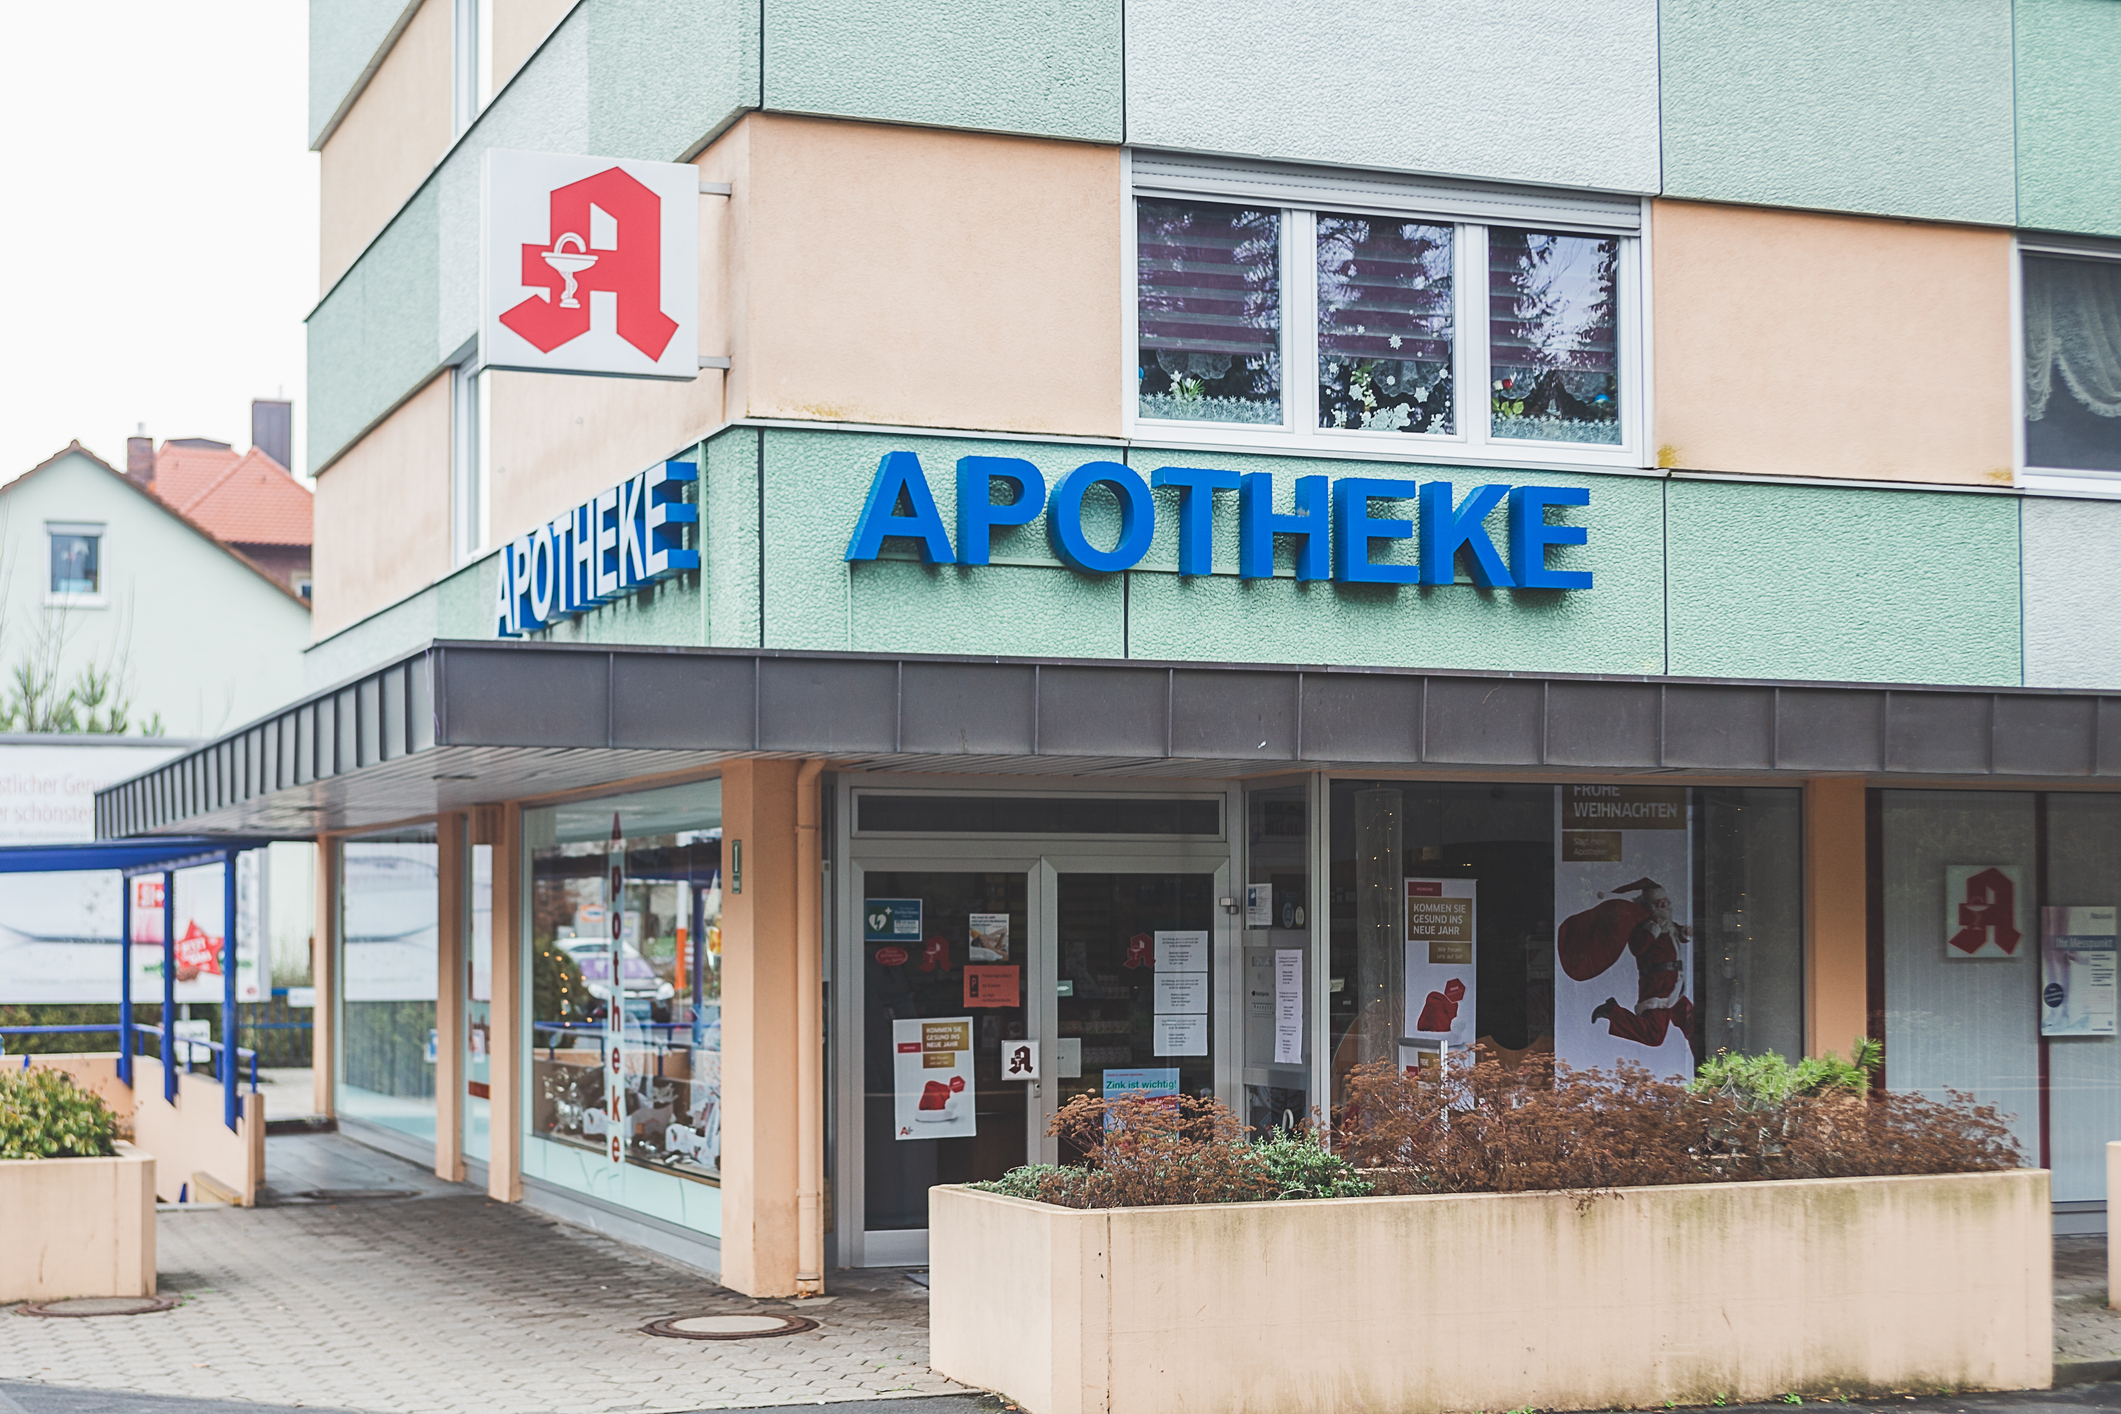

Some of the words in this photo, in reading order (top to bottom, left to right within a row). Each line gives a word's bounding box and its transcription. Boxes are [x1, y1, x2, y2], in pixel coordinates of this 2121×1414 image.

[846, 450, 1594, 592] APOTHEKE
[495, 461, 698, 641] APOTHEKE
[1573, 802, 1678, 818] WEIHNACHTEN
[1413, 903, 1452, 913] KOMMEN
[1453, 904, 1467, 914] SIE
[1413, 914, 1448, 924] GESUND
[1449, 915, 1464, 925] INS
[1413, 925, 1436, 935] NEUE
[1437, 926, 1460, 936] JAHR
[926, 1026, 953, 1034] KOMMEN
[926, 1033, 950, 1042] GESUND
[950, 1033, 961, 1041] INS
[926, 1041, 942, 1049] NEUE
[942, 1040, 959, 1048] JAHR
[1106, 1080, 1126, 1090] Zink
[1127, 1080, 1140, 1090] ist
[1141, 1079, 1178, 1091] wichtig!
